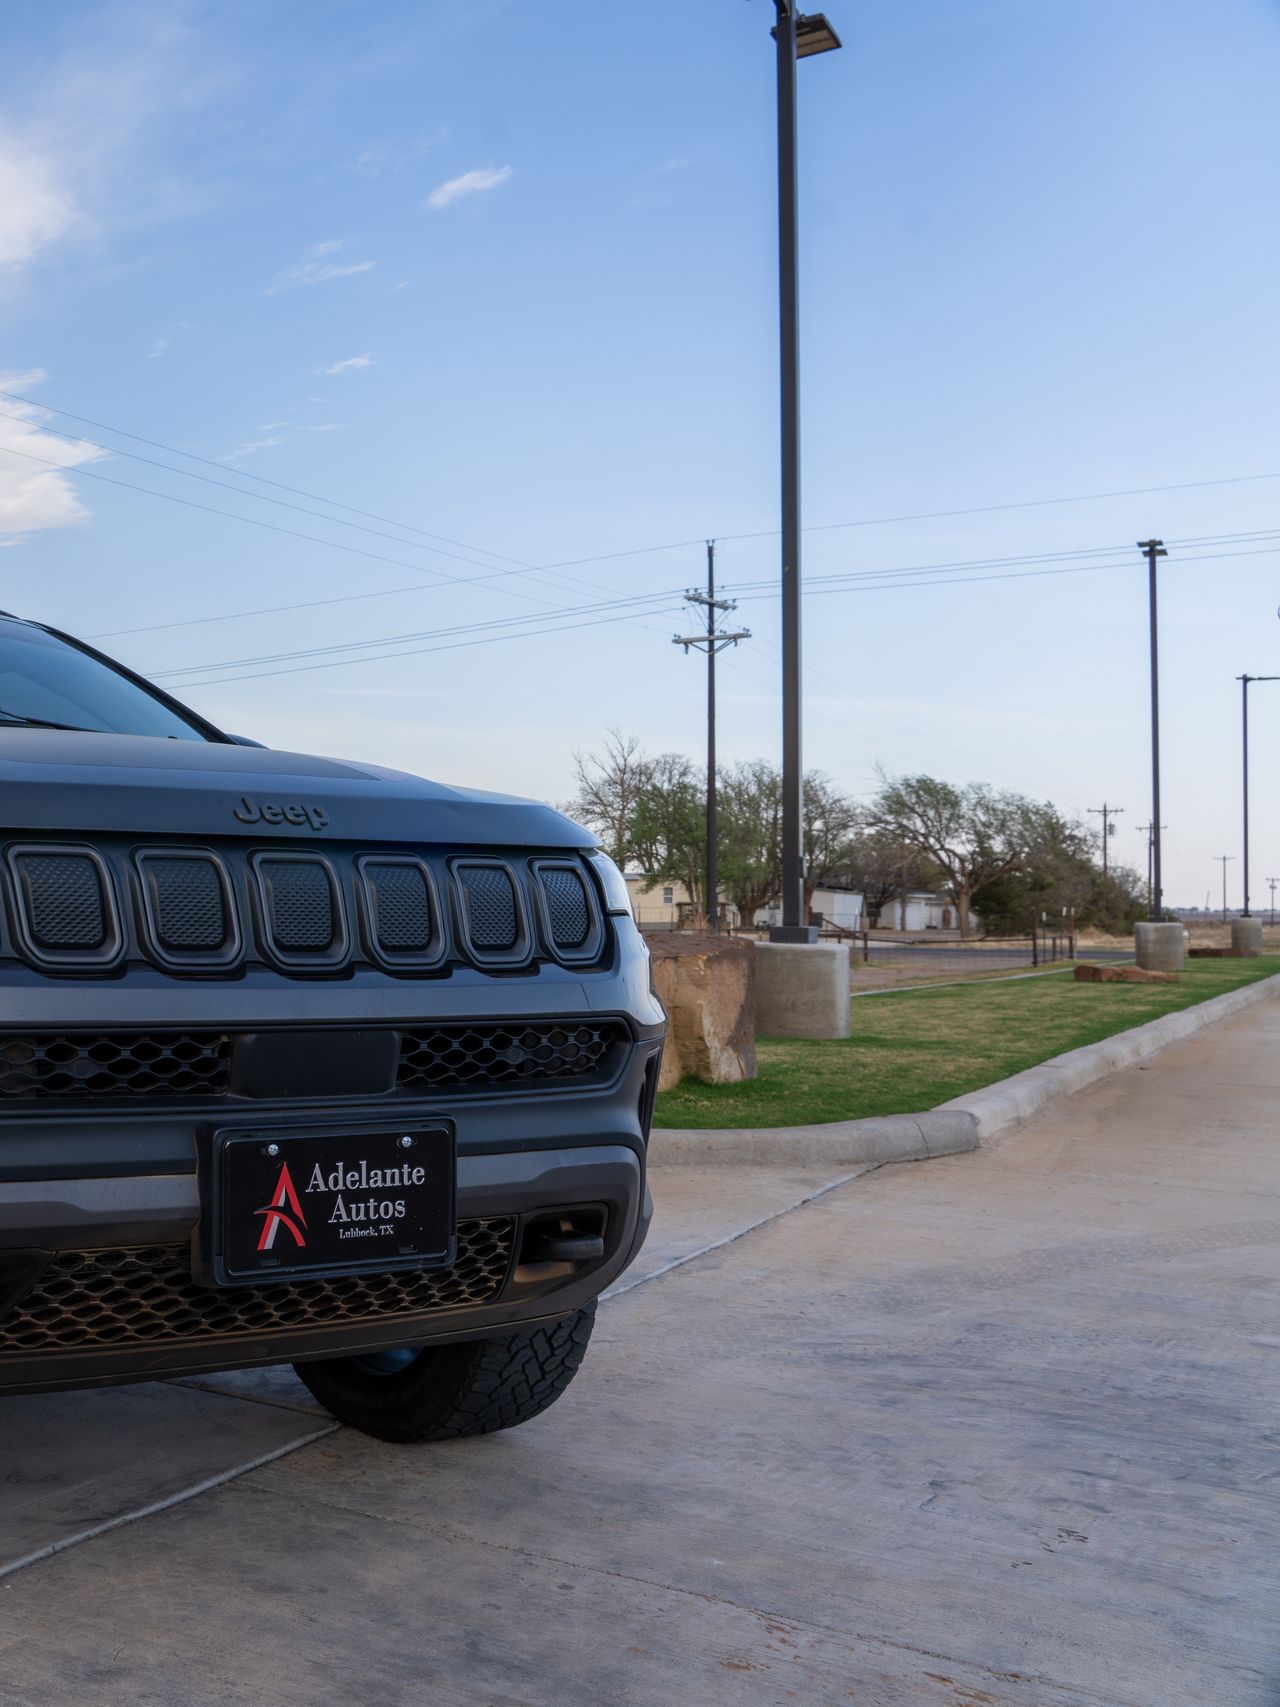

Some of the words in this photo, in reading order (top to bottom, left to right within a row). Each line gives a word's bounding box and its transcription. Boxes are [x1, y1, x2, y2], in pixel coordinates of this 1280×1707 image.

[233, 797, 329, 831] Jeep
[305, 1160, 426, 1193] Adelante
[327, 1194, 406, 1223] Autos
[379, 1225, 394, 1236] TX
